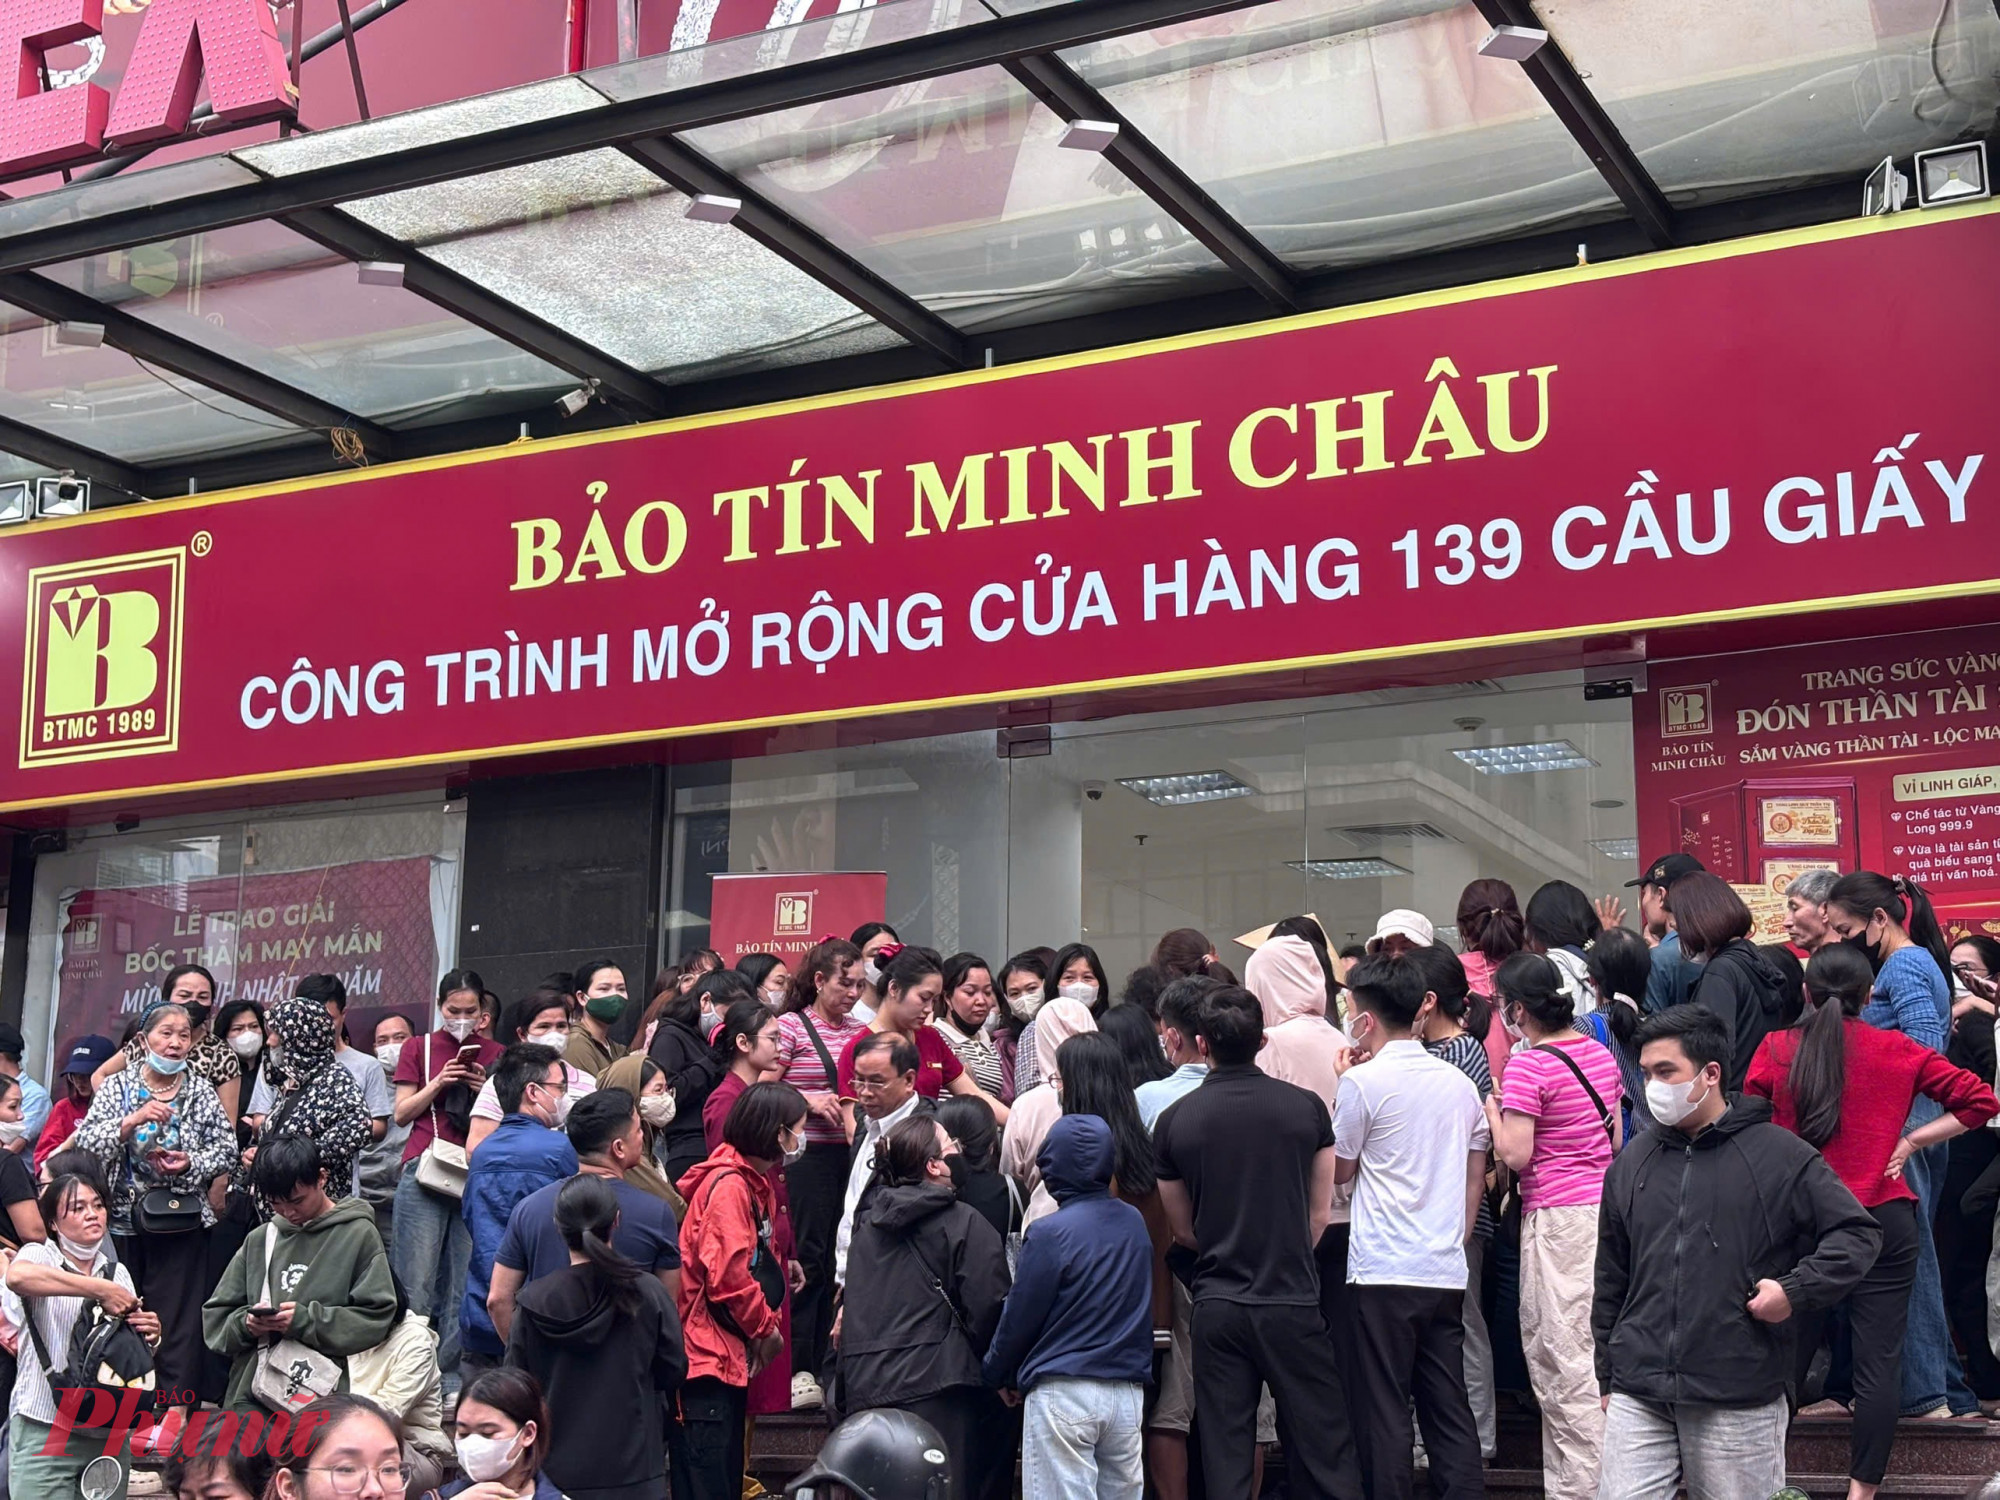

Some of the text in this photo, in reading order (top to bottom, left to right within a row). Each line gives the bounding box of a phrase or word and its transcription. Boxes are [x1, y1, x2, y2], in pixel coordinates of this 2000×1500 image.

[510, 357, 1558, 591] BẢO TÍN MINH CHÂU
[241, 432, 1985, 730] CÔNG TRÌNH MỞ RỘNG CỬA HÀNG 139 CẦU GIẤY
[1801, 651, 2000, 691] TRANG SỨC VÀN
[1736, 699, 1810, 735] ĐÓN
[1820, 687, 1918, 726] THẦN
[1927, 680, 1987, 715] TÀI
[43, 708, 156, 743] BTMC 1989
[1691, 740, 1714, 753] TÍN
[1739, 743, 1777, 764] SẮM
[1781, 741, 1831, 760] VÀNG
[1834, 734, 1885, 755] THẦN
[1888, 731, 1918, 749] TÀI
[1933, 726, 1970, 747] LỘC
[1651, 754, 1726, 772] MINH CHÂU
[1920, 778, 1953, 793] LINH
[1958, 773, 1997, 789] GIÁP,
[1905, 804, 2000, 821] Chế tác từ Vàng
[1906, 819, 1973, 835] Long 999.9
[1908, 844, 1932, 856] Vừa
[1935, 843, 1946, 854] là
[1950, 841, 1964, 852] tài
[1967, 838, 1989, 851] sản
[1908, 857, 1931, 871] quà
[1934, 855, 1960, 867] biếu
[1963, 854, 1993, 866] sang
[1909, 866, 1998, 883] giá trị văn hoá.
[174, 895, 335, 936] LỄ TRAO GIẢI
[125, 923, 383, 974] BỐC THĂM MAY MẮN
[736, 941, 760, 954] BẢO
[762, 939, 782, 953] TÍN
[120, 981, 163, 1015] MỪN
